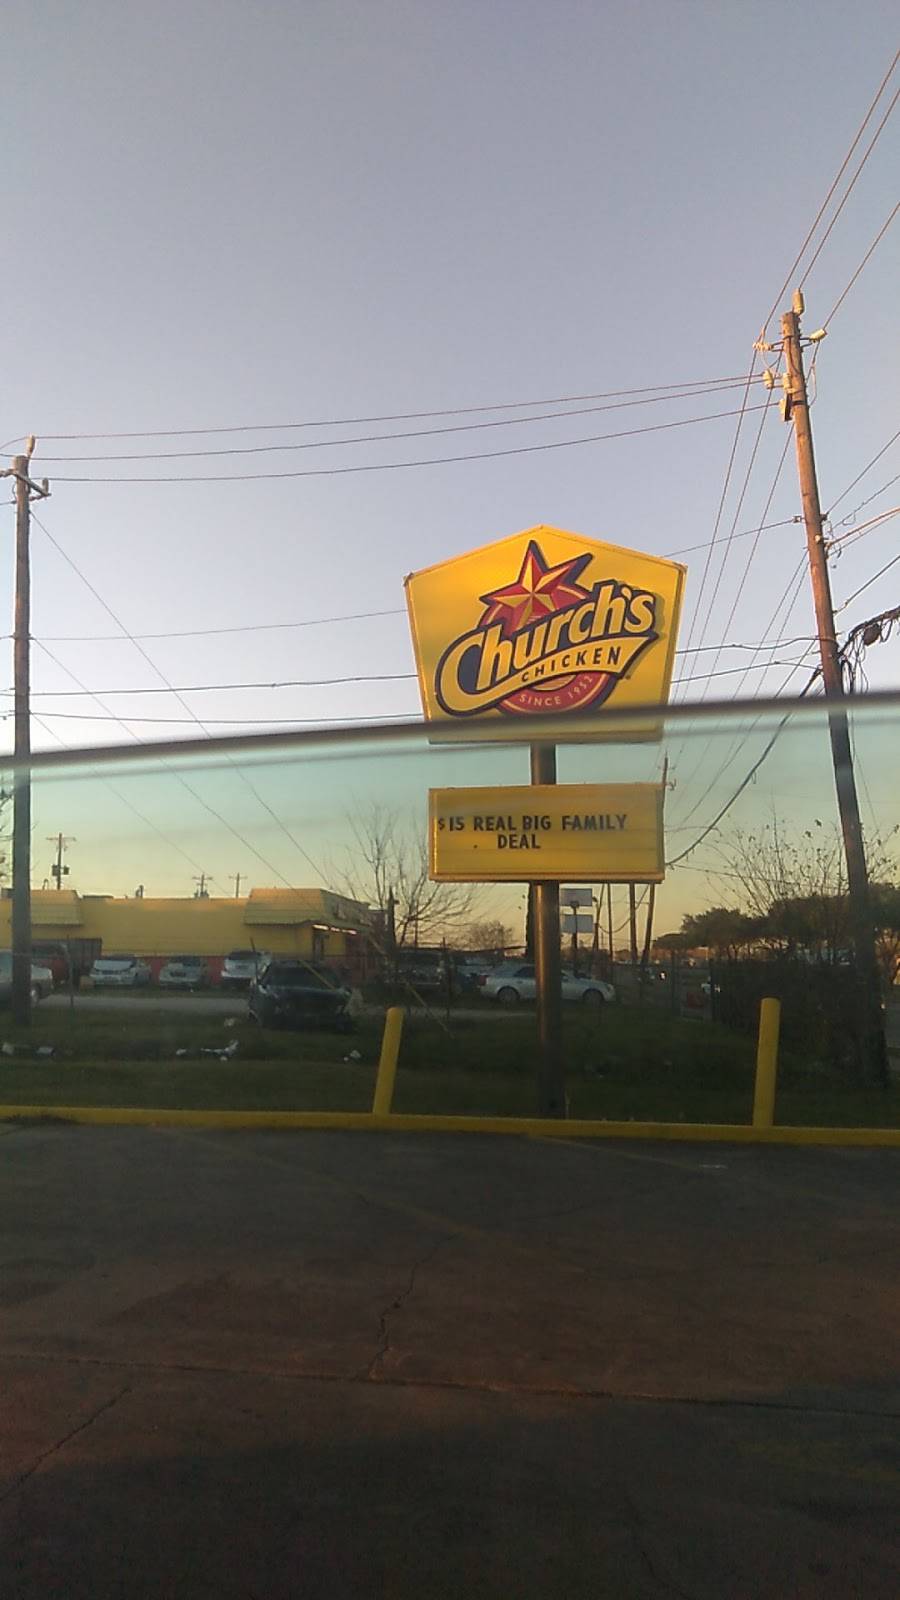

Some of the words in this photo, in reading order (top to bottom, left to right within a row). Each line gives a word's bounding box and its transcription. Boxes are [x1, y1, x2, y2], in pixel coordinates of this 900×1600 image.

[437, 583, 655, 712] Church's
[521, 646, 621, 682] CHICKEN
[520, 693, 561, 706] SINCE
[567, 675, 593, 698] 1952
[473, 815, 517, 831] REAL
[522, 815, 551, 830] BIG
[562, 814, 627, 830] FAMILY
[497, 834, 541, 849] DEAL
